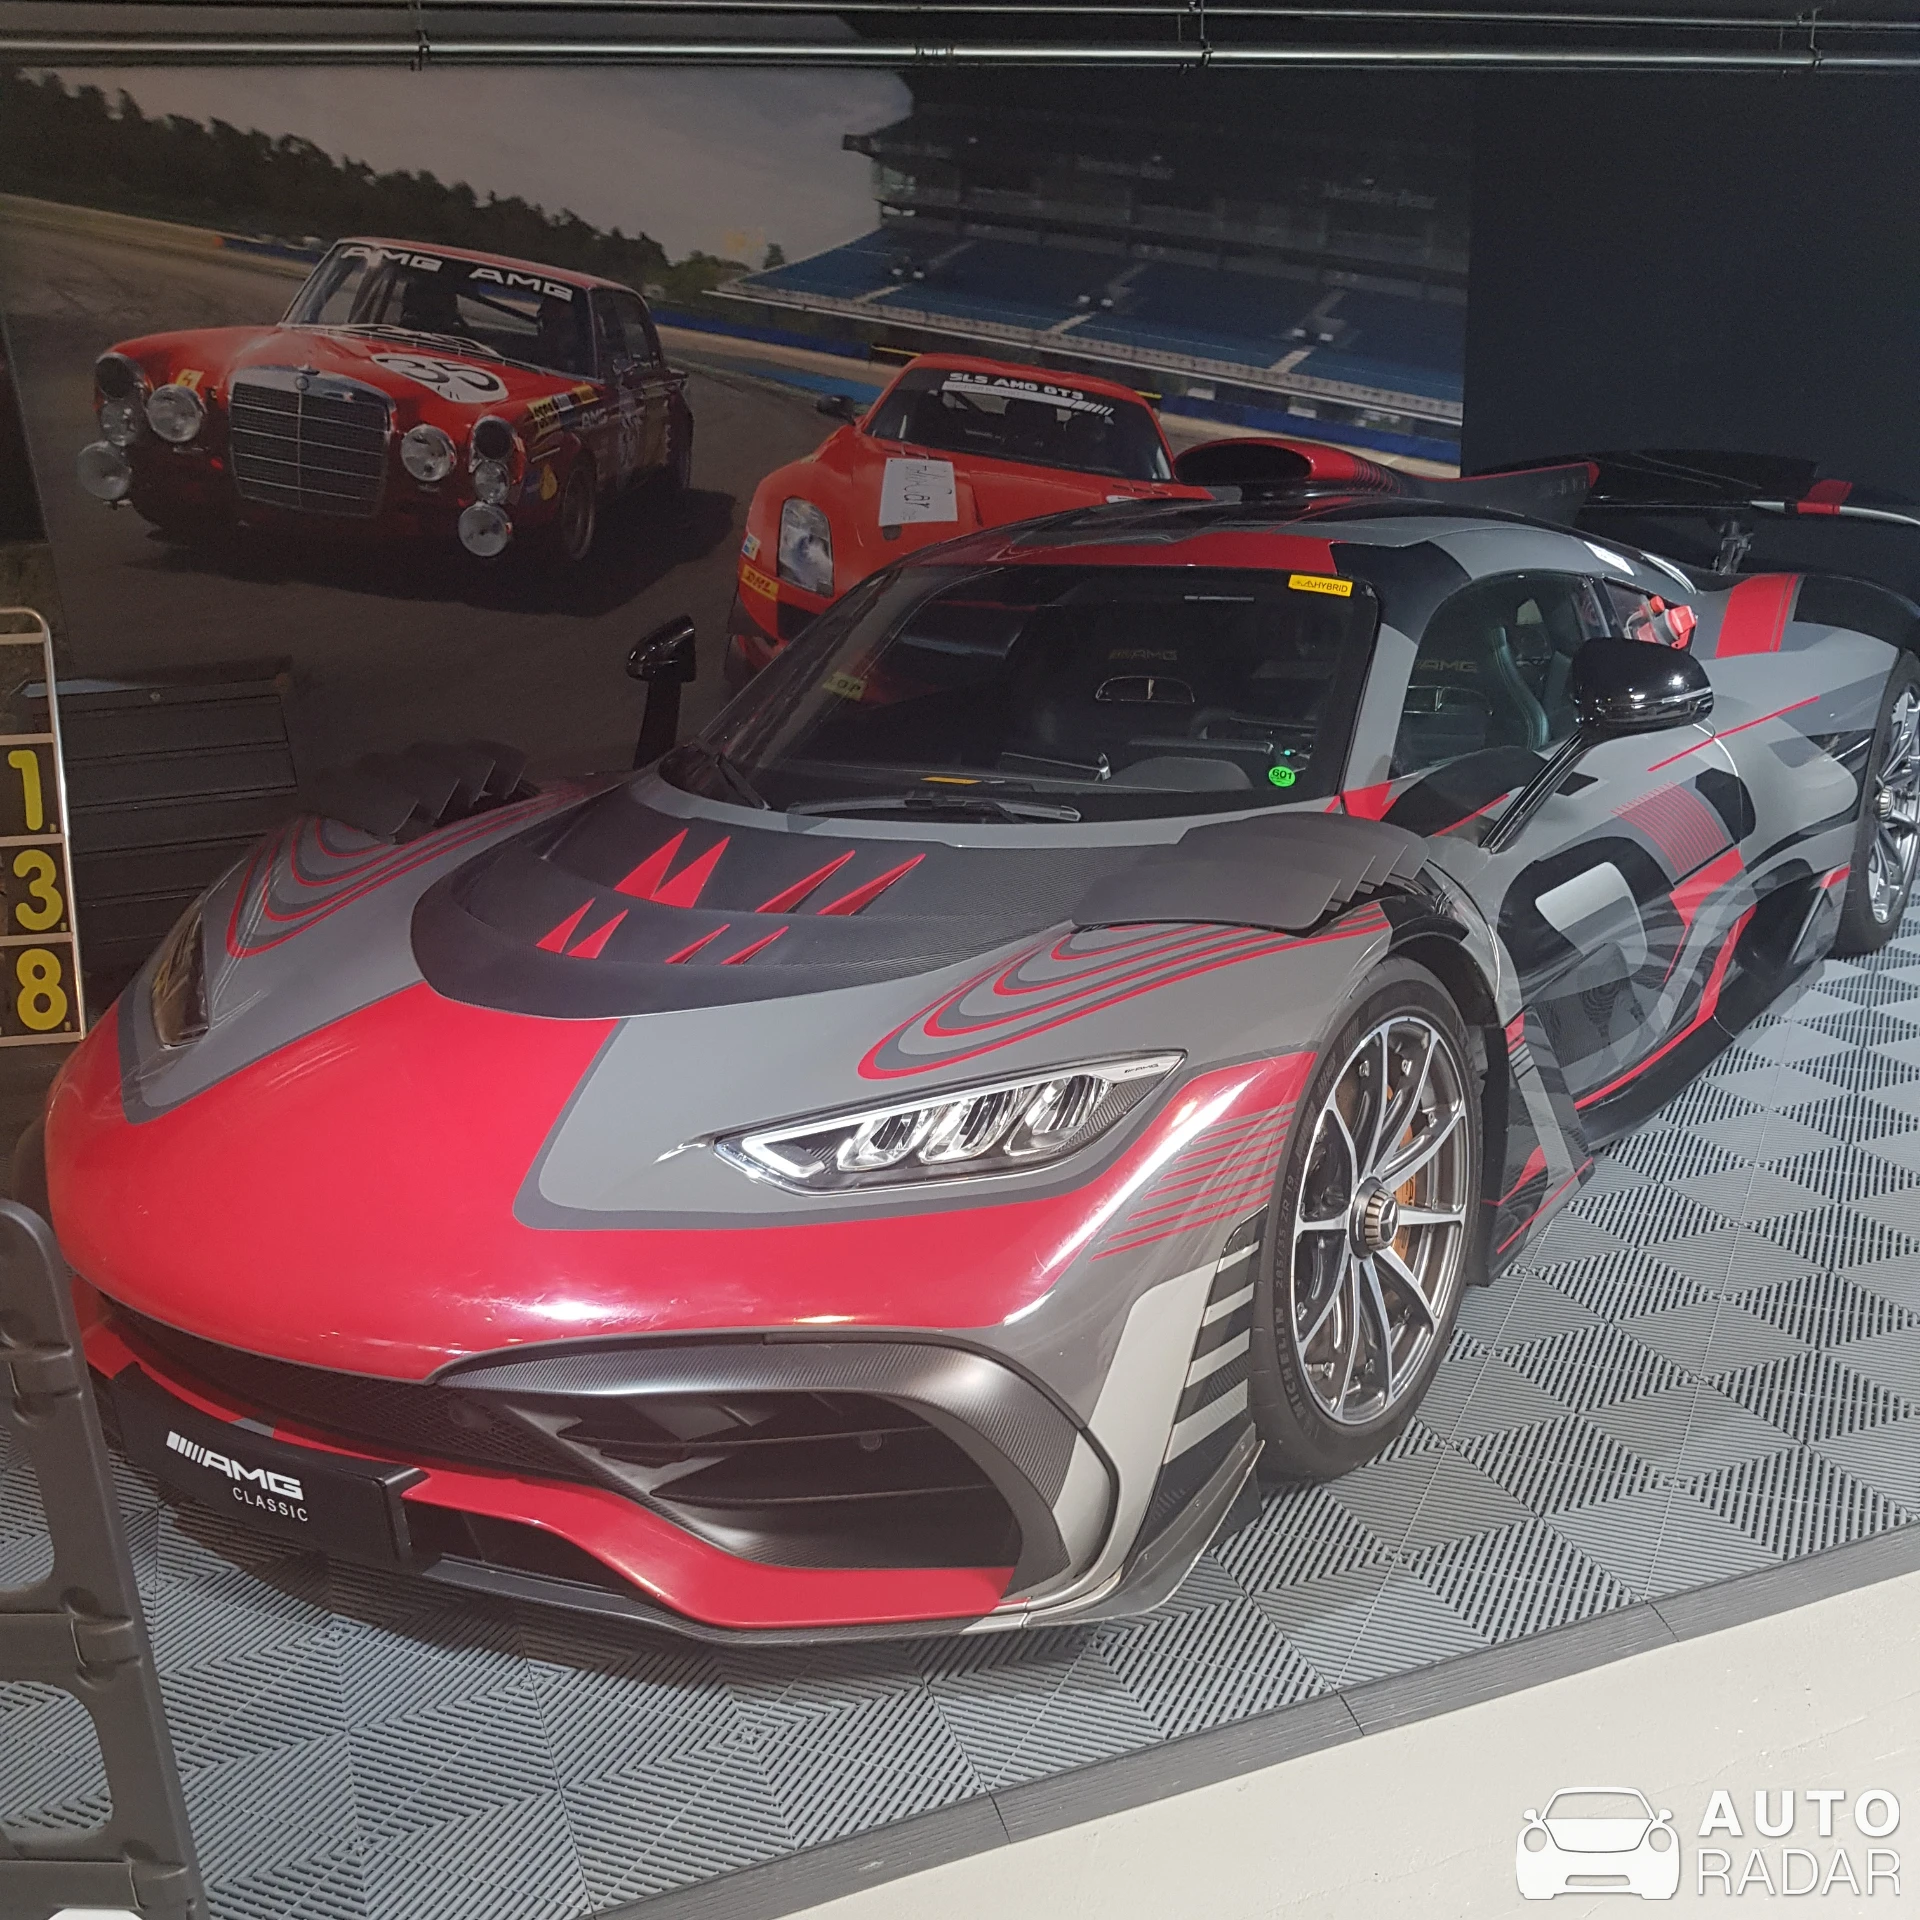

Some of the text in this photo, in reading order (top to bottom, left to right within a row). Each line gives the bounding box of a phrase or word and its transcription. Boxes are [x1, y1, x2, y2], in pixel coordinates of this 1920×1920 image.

[341, 247, 573, 302] AMG AMG
[376, 358, 500, 392] 35
[950, 372, 988, 384] SLS
[993, 378, 1039, 392] AMG
[1043, 385, 1084, 400] GT3
[1314, 581, 1348, 593] HYBRID
[8, 750, 43, 831] 1
[1272, 769, 1292, 779] 601
[13, 850, 63, 931] 3
[16, 949, 68, 1030] 8
[1275, 1307, 1307, 1418] MICHELIN
[201, 1450, 304, 1500] AMG
[232, 1487, 309, 1522] CLASSIC
